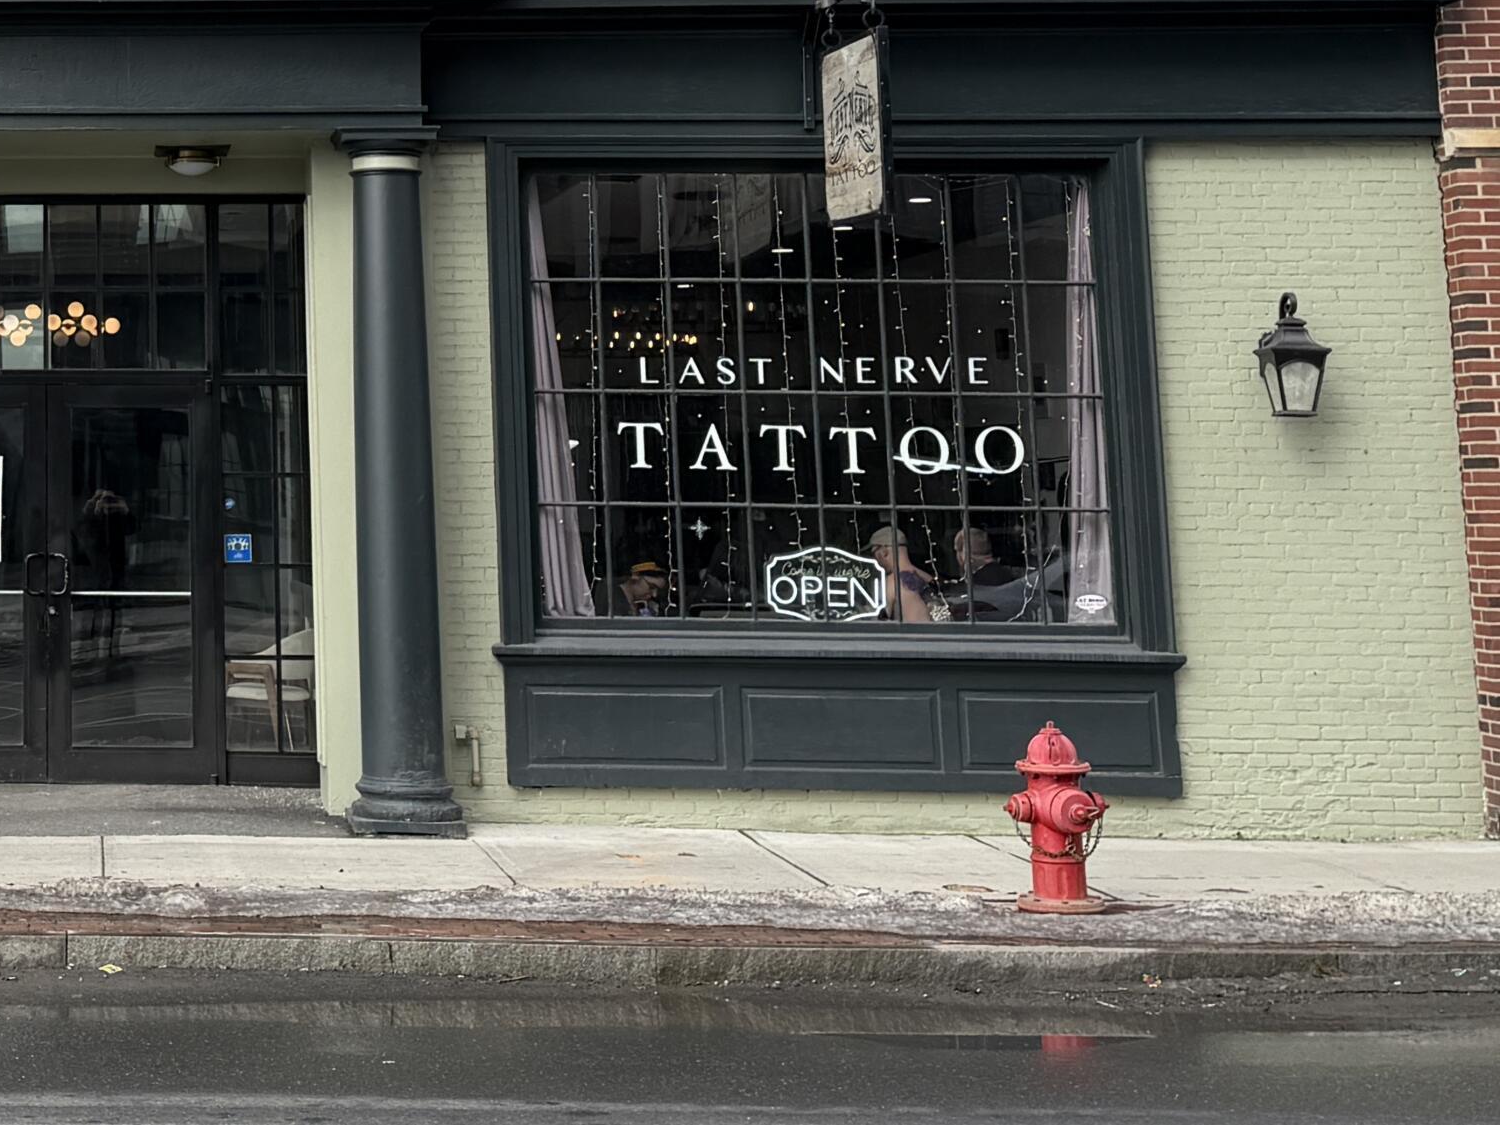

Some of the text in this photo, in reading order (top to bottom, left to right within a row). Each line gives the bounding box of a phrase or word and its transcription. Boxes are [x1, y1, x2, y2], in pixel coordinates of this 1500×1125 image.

[829, 160, 878, 186] TATTOO
[639, 356, 989, 384] LAST NERVE
[617, 421, 1025, 475] TATTOO
[772, 576, 879, 609] OPEN
